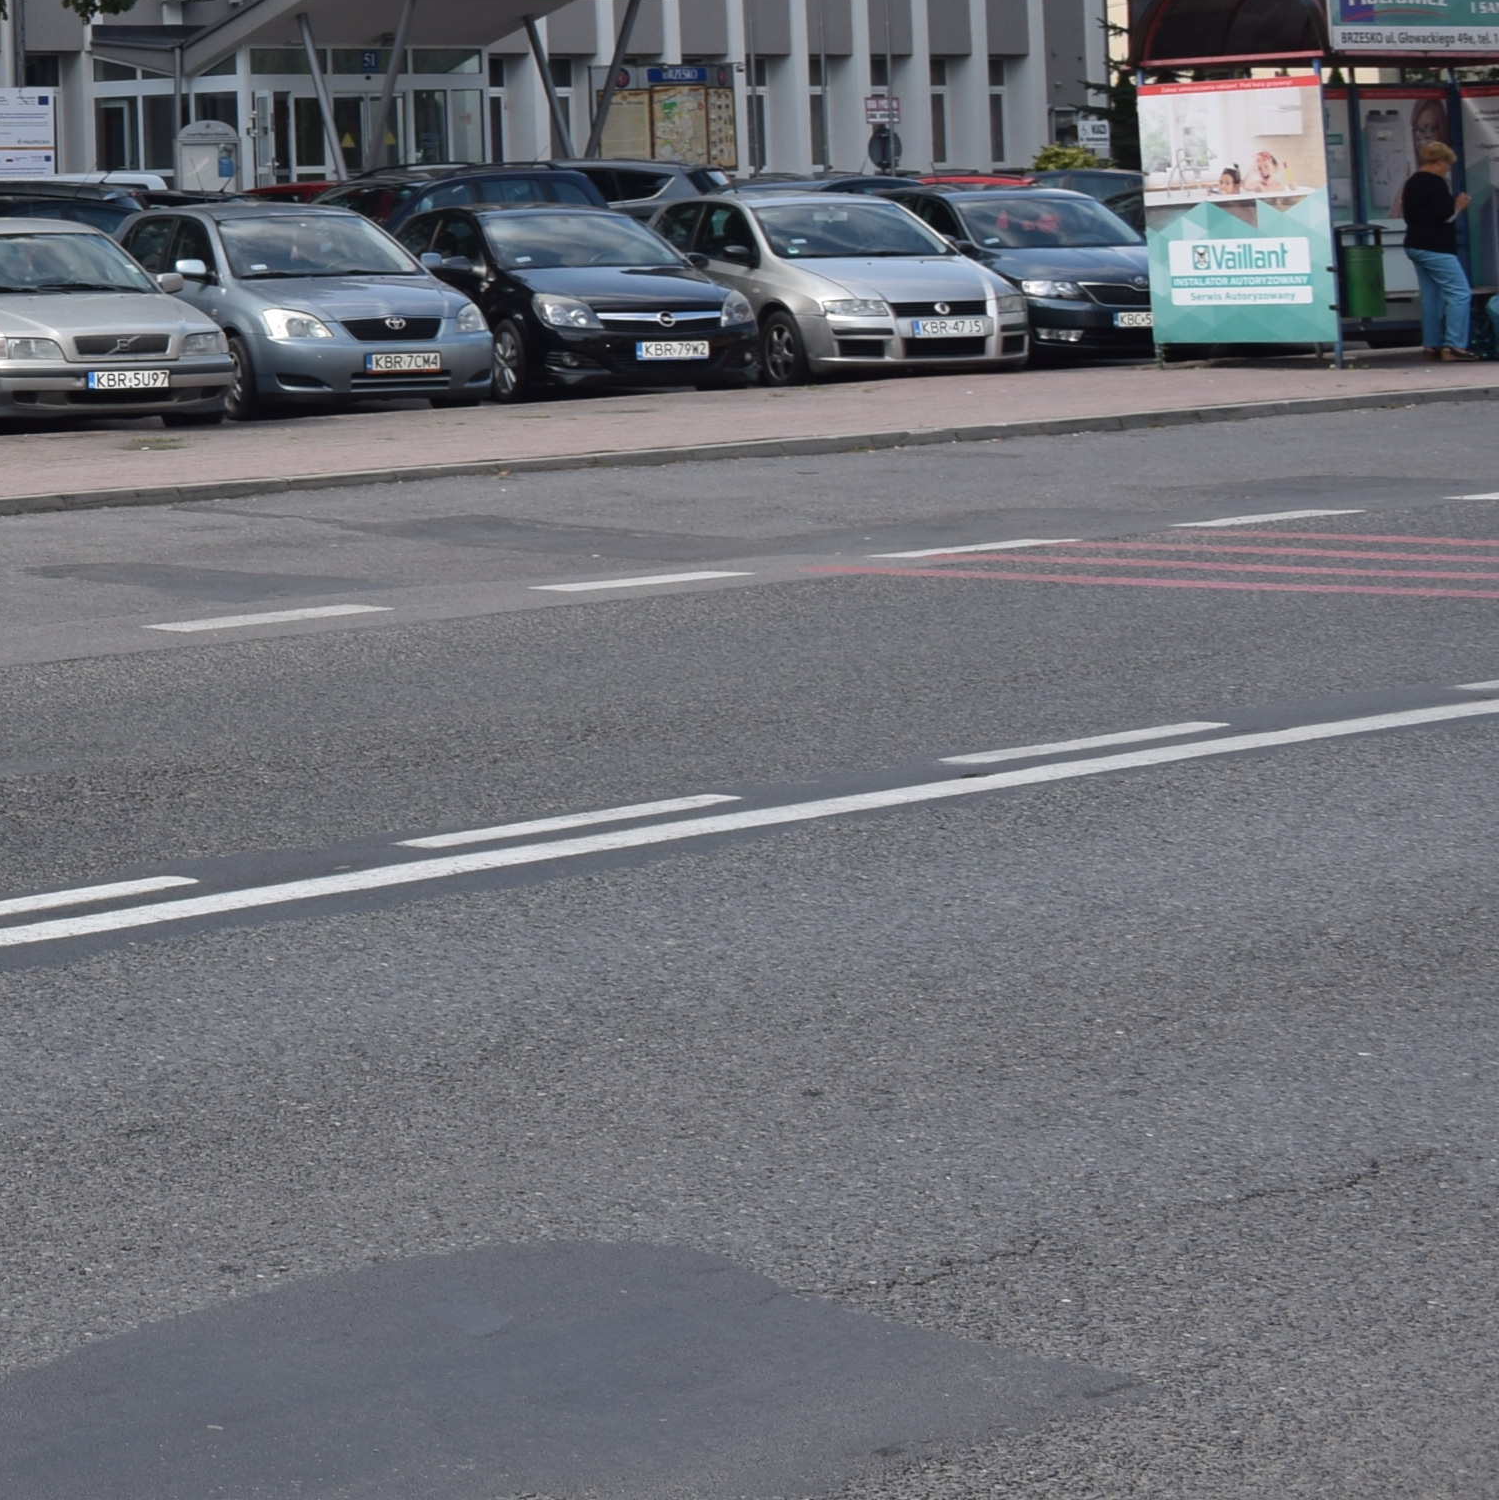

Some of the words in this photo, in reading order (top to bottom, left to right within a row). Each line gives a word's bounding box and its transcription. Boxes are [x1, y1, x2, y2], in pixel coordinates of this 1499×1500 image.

[1341, 31, 1383, 44] BRZESKO
[1398, 31, 1456, 48] Głowackiego
[363, 52, 375, 67] 51
[1211, 242, 1288, 270] Vaillant
[1173, 276, 1229, 287] INSTALATOR
[1230, 275, 1309, 286] AUTORYZOWANY
[1190, 291, 1222, 301] Serwis
[1224, 291, 1296, 301] Autoryzowany
[1120, 313, 1141, 325] KBC
[921, 321, 949, 334] KBR
[644, 343, 673, 356] KBR
[677, 342, 706, 356] 79W2
[374, 355, 403, 369] KBR
[407, 354, 438, 368] 7CM4
[96, 373, 127, 388] KBR
[133, 371, 168, 387] 5U97
